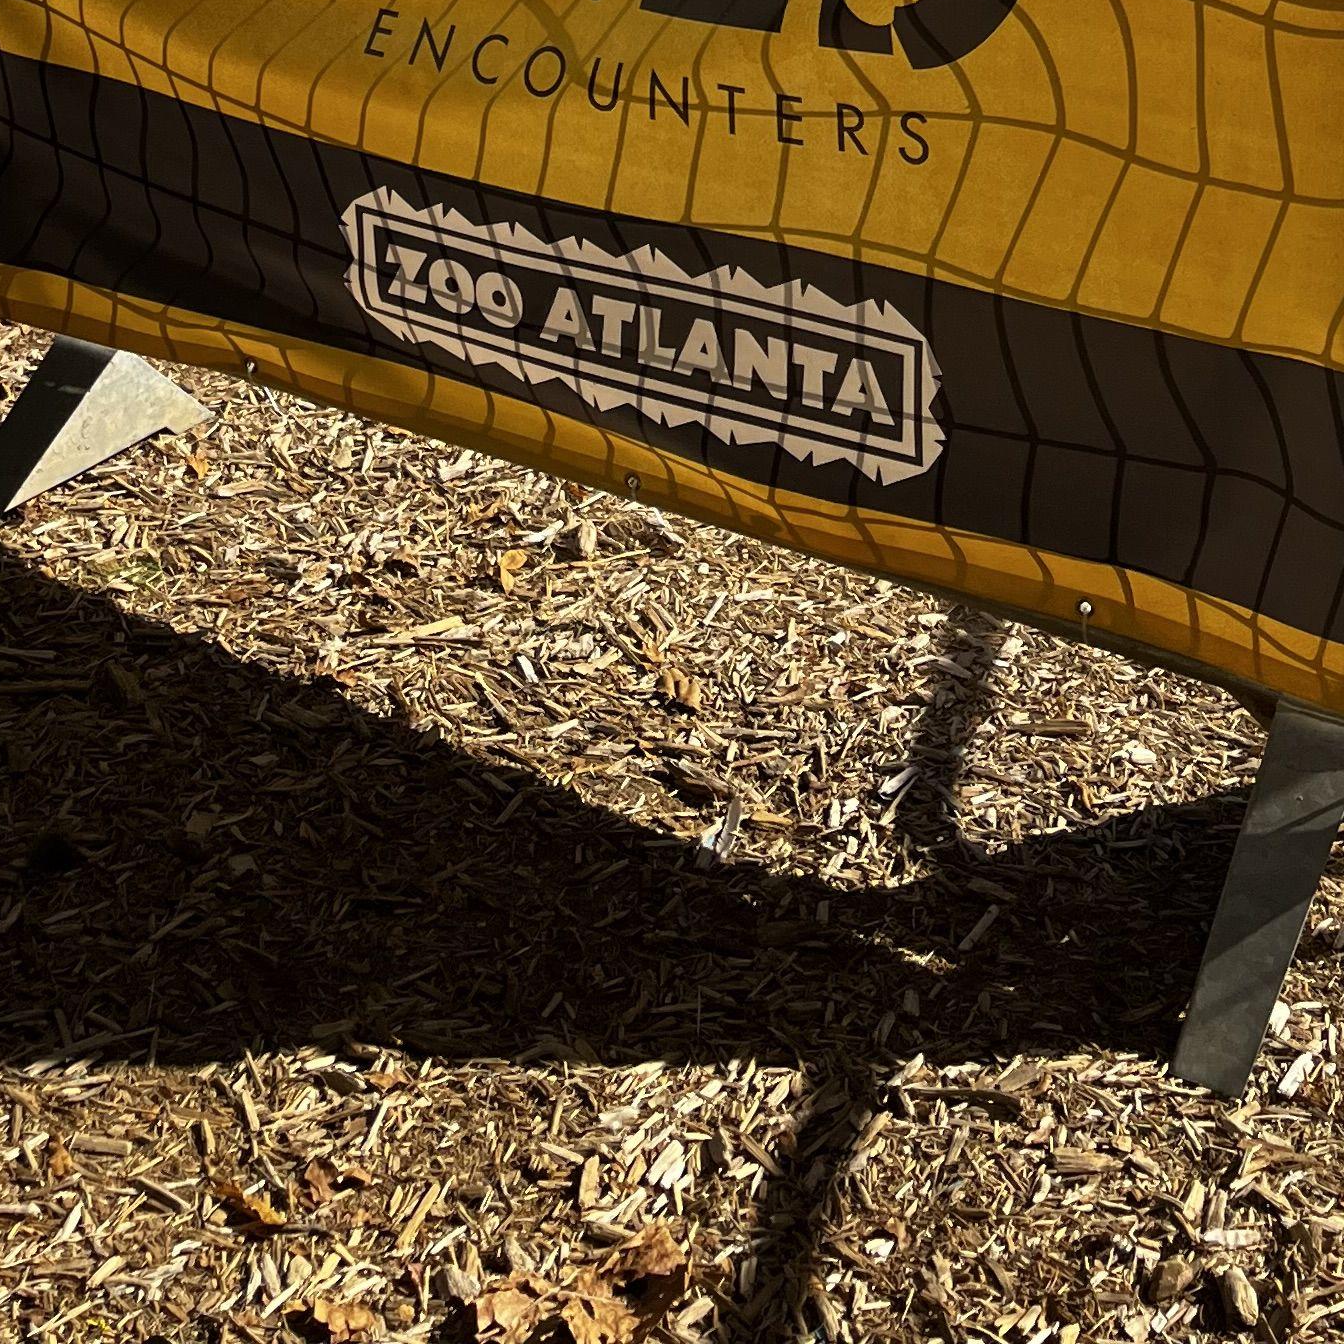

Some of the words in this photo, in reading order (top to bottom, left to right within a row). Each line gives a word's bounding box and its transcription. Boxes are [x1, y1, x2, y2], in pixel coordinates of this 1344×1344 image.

[363, 7, 931, 166] ENCOUNTERS
[385, 243, 524, 329] ZOO
[539, 288, 895, 427] ATLANTA
